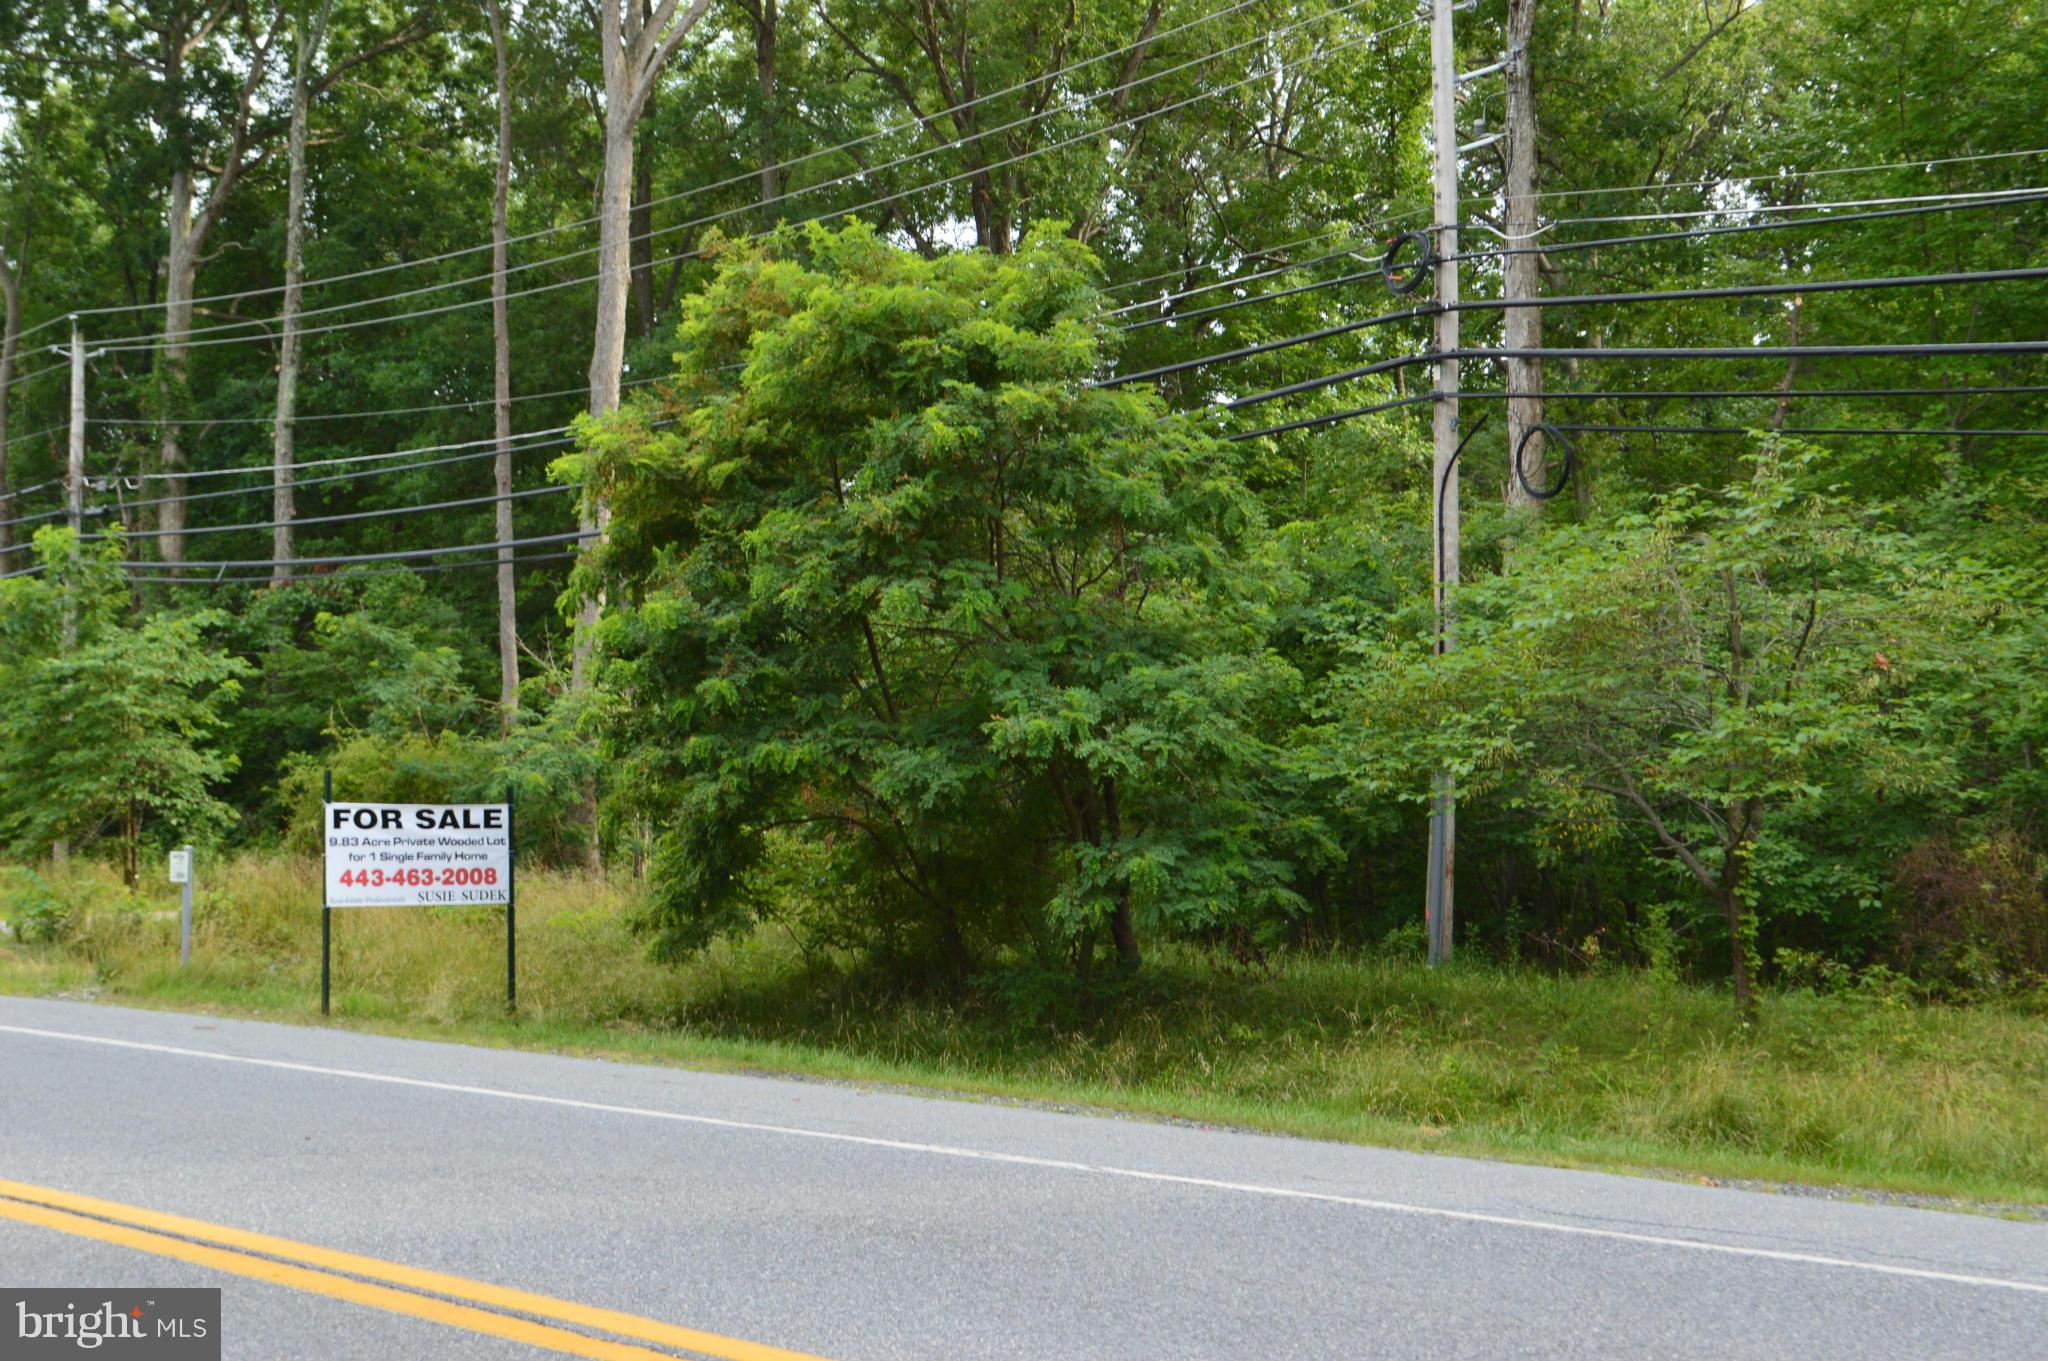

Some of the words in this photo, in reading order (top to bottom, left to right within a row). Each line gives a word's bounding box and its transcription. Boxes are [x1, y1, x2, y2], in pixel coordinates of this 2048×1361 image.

[333, 809, 403, 829] FOR
[416, 808, 503, 829] SALE
[329, 837, 359, 847] 9.83
[362, 837, 391, 846] Acre
[394, 836, 435, 846] Private
[438, 836, 485, 846] Wooded
[487, 836, 506, 846] Lot
[349, 852, 366, 861] for
[369, 852, 375, 861] 1
[380, 852, 415, 863] Single
[416, 852, 453, 863] Family
[454, 851, 488, 861] Home
[339, 867, 498, 887] 443-463-2008
[417, 890, 456, 902] SUSIE
[461, 889, 507, 902] SUDEK
